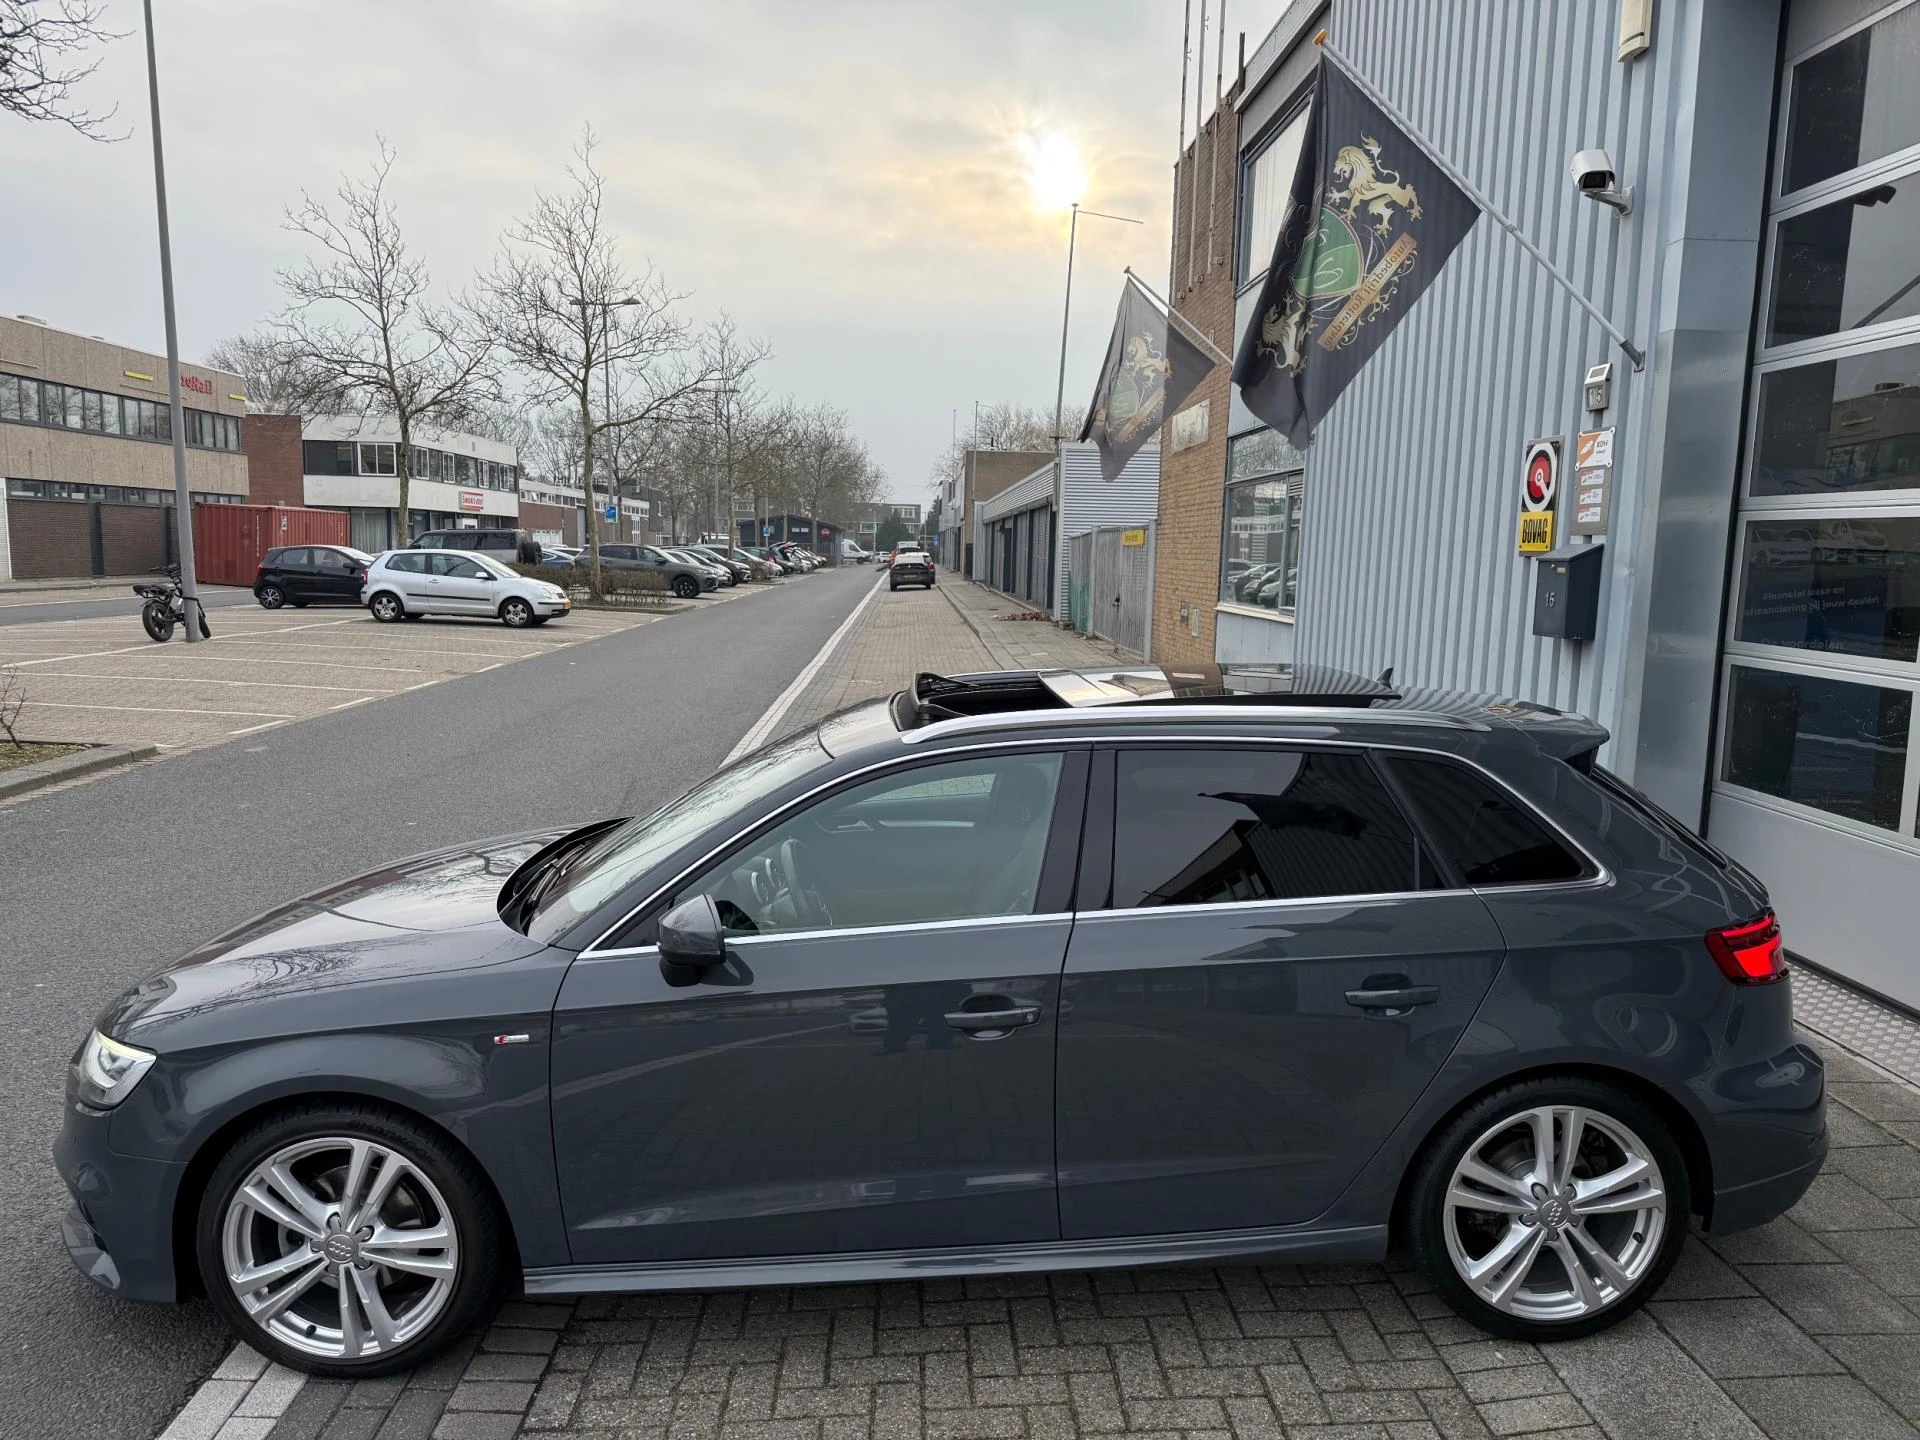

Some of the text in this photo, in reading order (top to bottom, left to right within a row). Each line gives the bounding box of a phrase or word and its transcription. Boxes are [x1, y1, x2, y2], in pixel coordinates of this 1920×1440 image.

[1590, 387, 1603, 405] 15
[1521, 518, 1548, 544] BOVAG
[1544, 591, 1555, 608] 15
[1763, 588, 1806, 600] Financial
[1822, 600, 1845, 610] jouw
